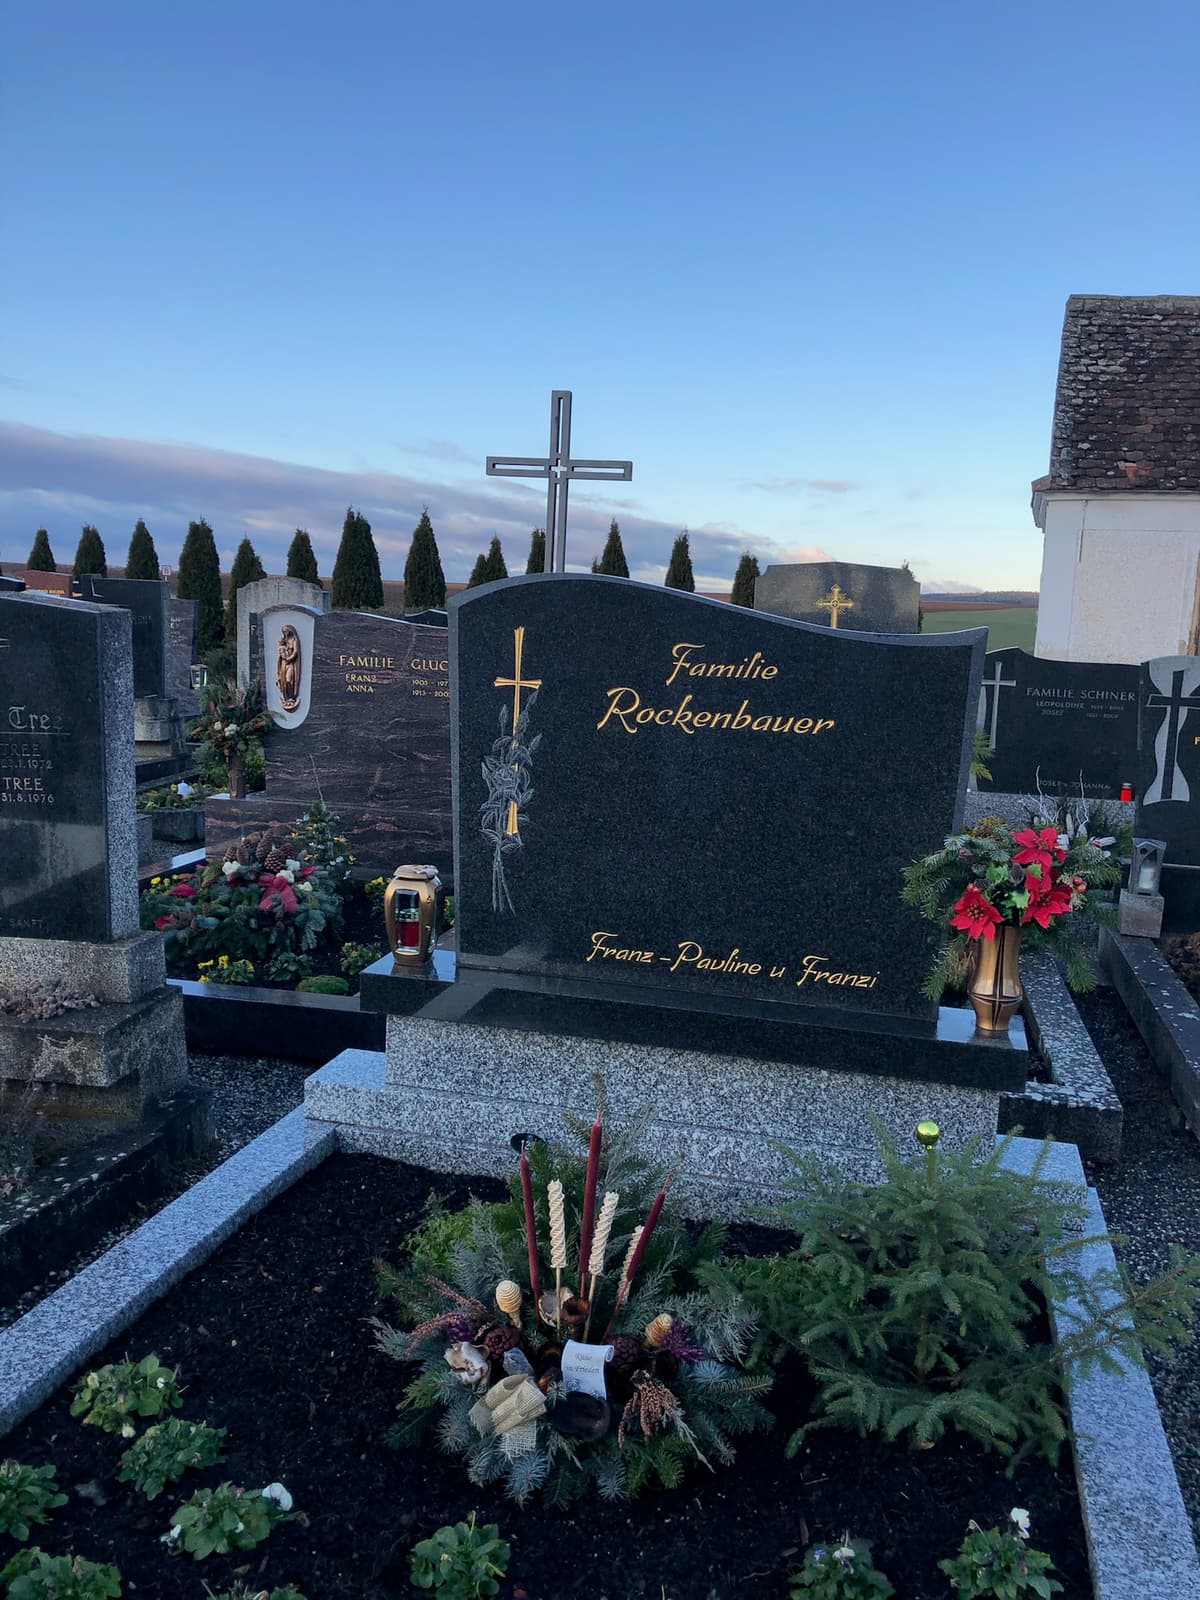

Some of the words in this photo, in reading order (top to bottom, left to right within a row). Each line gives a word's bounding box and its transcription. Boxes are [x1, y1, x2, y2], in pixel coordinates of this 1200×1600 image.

[339, 654, 395, 669] FAMILIE
[665, 642, 779, 686] Familie
[345, 673, 377, 683] FRANZ
[346, 684, 374, 694] ANNA
[1026, 687, 1075, 699] FAMILIE
[1080, 689, 1136, 702] SCHINER
[597, 686, 836, 735] Rockenbauer
[2, 777, 44, 791] TREE
[769, 965, 786, 978] u
[796, 955, 881, 988] Franzi
